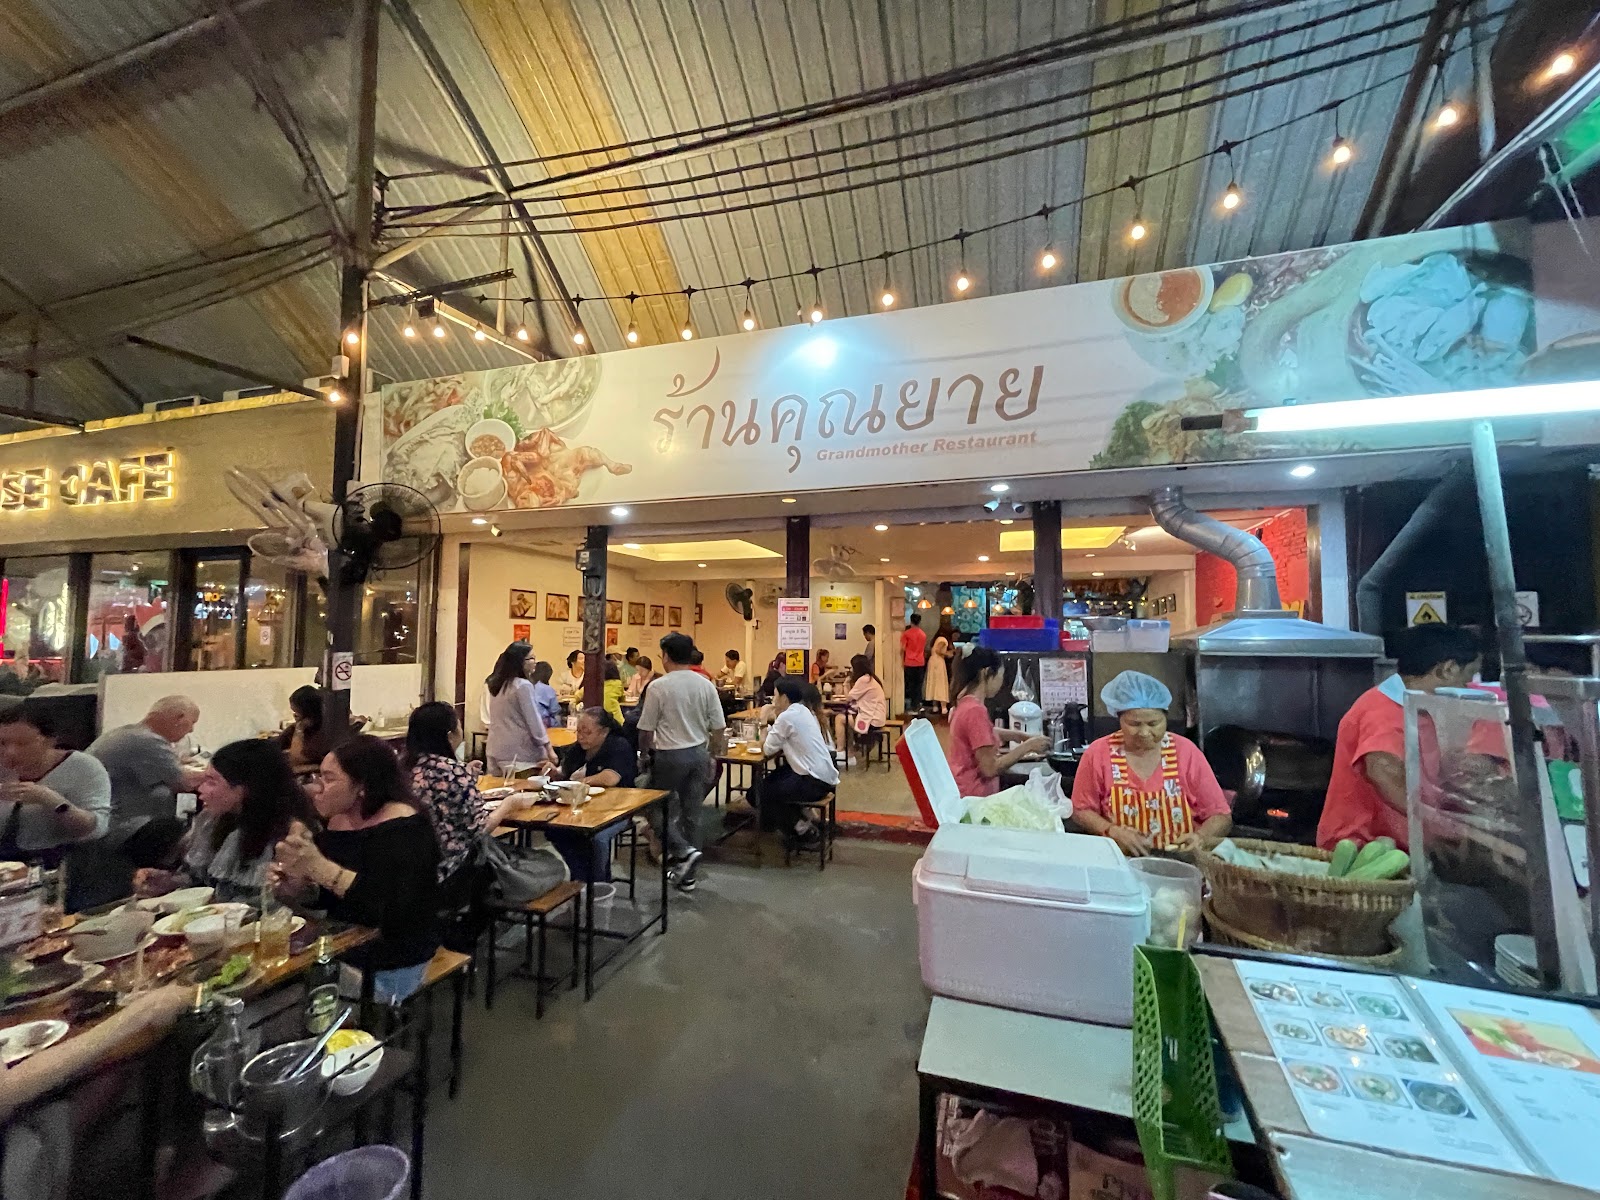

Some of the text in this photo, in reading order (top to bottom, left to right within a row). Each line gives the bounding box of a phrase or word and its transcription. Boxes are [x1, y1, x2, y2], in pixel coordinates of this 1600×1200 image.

[653, 346, 1044, 473] ร้านคุณยาย
[816, 430, 1038, 461] Grandmother Restaurant
